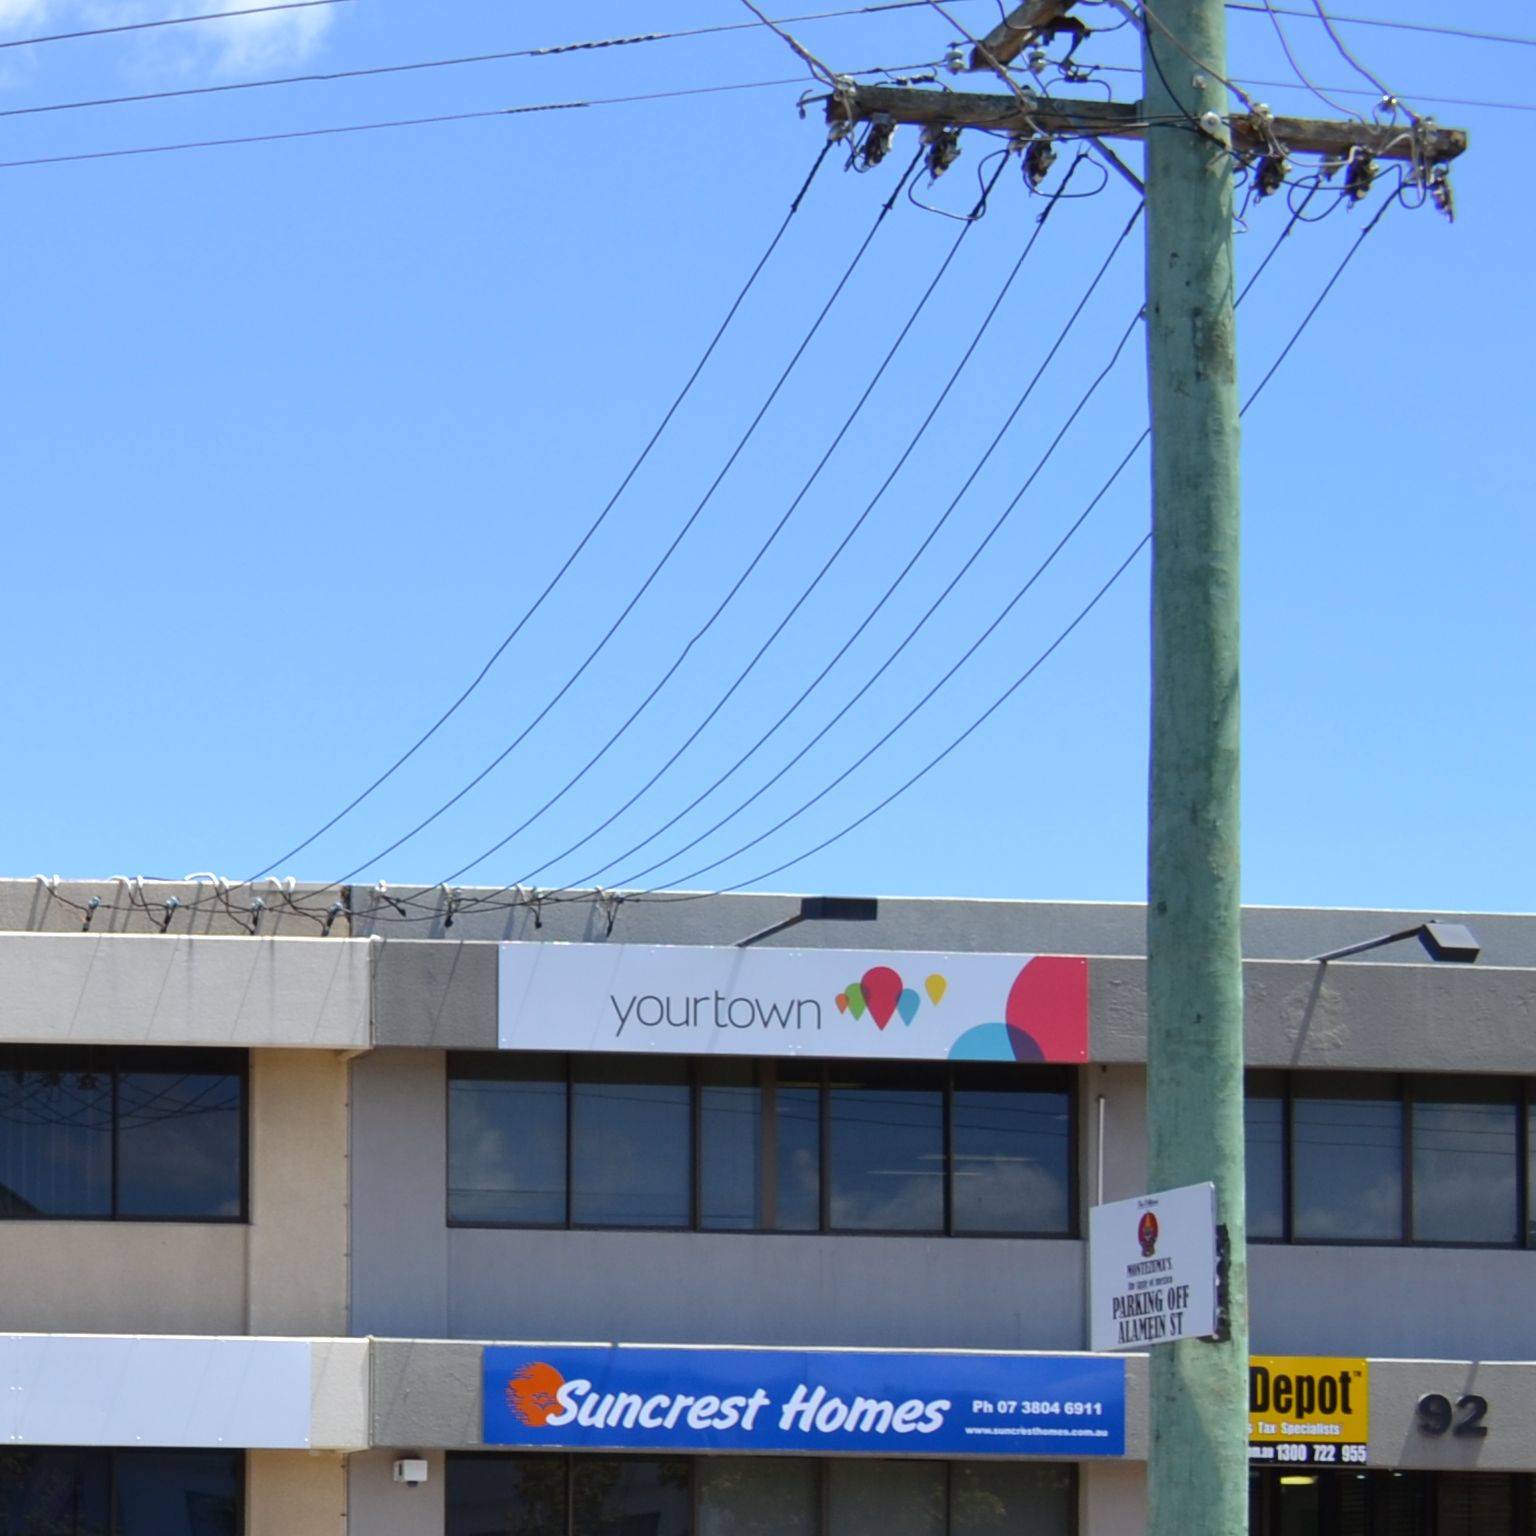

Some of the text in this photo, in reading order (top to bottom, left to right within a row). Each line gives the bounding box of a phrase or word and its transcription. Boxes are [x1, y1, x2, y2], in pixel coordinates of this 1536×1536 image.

[610, 990, 821, 1037] yourtown
[1112, 1285, 1190, 1320] PARKING OFF
[1118, 1312, 1184, 1344] ALAMEIN ST
[546, 1379, 950, 1434] Suncrest Homes
[972, 1400, 1102, 1415] Ph 07 3804 6911
[1418, 1394, 1488, 1437] 92
[1258, 1422, 1276, 1433] Tax
[1276, 1445, 1307, 1461] 1300
[1313, 1445, 1335, 1462] 722
[1342, 1445, 1366, 1462] 955
